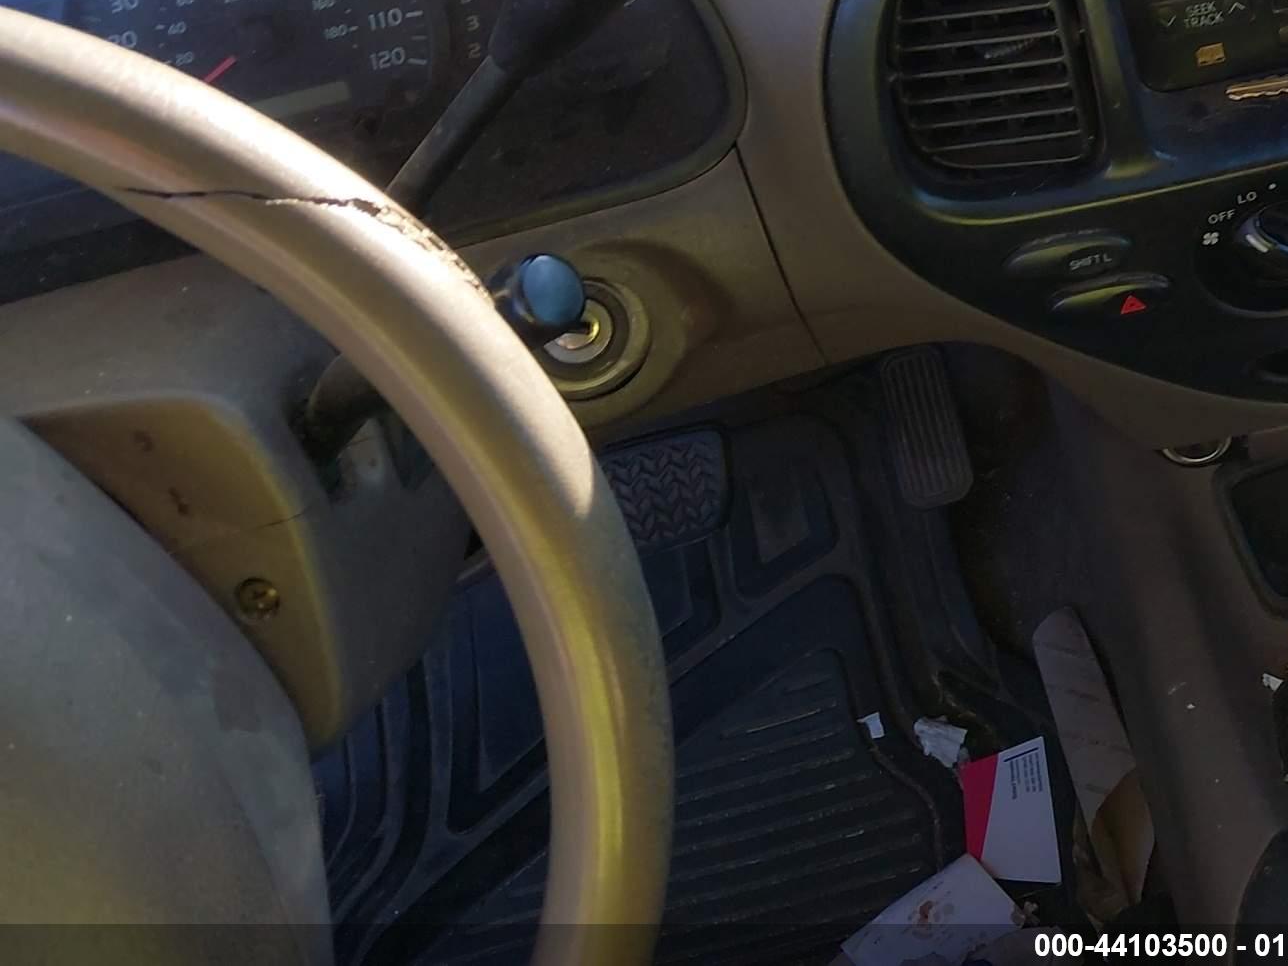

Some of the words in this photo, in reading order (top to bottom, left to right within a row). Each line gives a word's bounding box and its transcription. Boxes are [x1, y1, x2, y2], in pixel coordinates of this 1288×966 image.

[1185, 0, 1217, 16] SEEK
[368, 7, 403, 31] 110
[465, 15, 481, 31] 3
[1184, 11, 1224, 30] TRACK
[370, 46, 406, 71] 120
[467, 42, 481, 59] 2
[1236, 190, 1259, 206] LO
[1207, 209, 1237, 225] OFF
